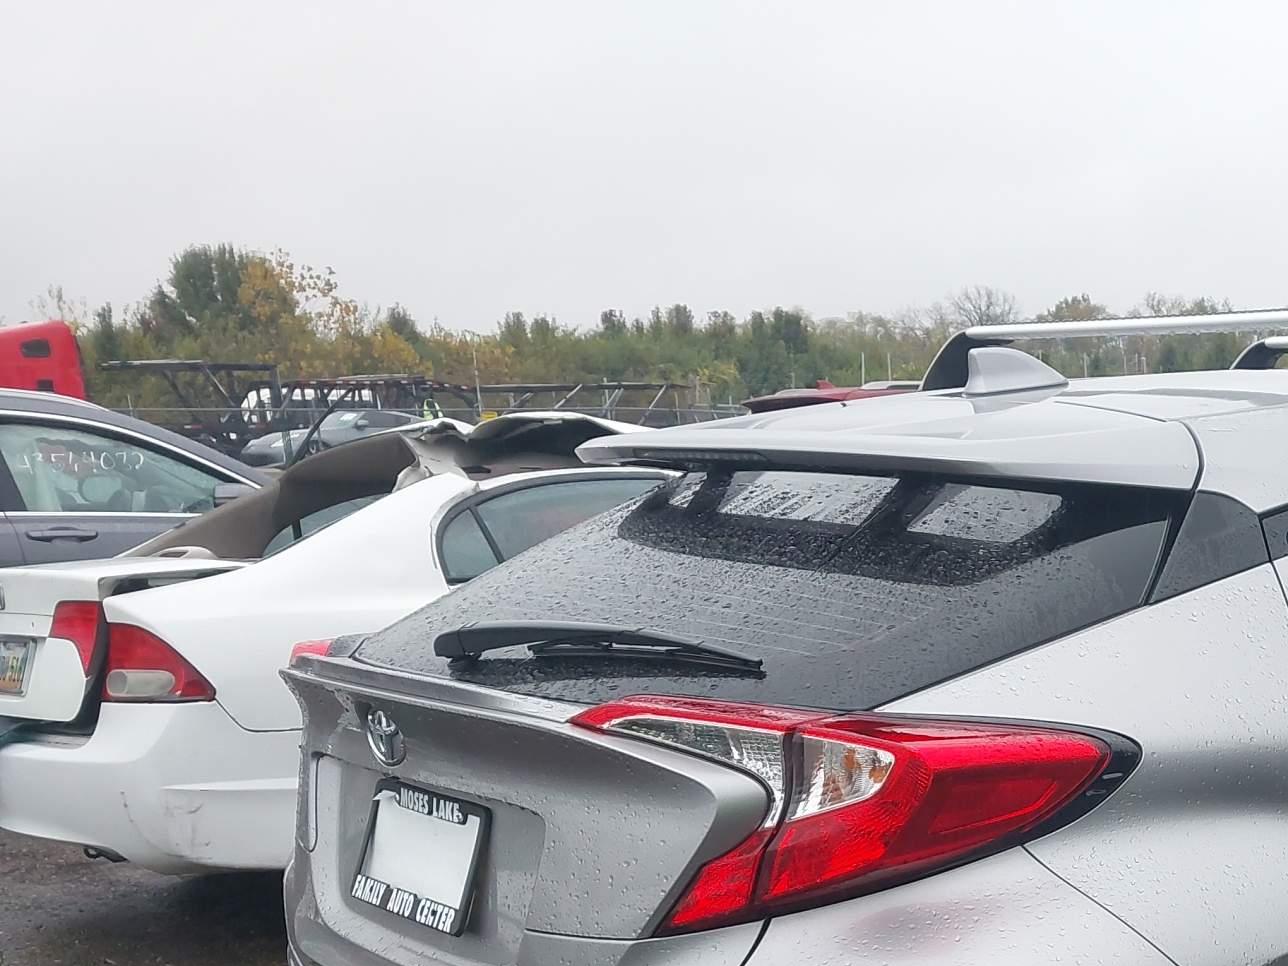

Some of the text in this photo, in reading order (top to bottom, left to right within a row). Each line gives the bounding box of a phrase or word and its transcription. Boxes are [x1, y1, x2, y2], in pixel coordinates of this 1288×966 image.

[400, 787, 461, 823] MOSES LAKE
[351, 874, 456, 933] FAMILY AUTO CENTER
